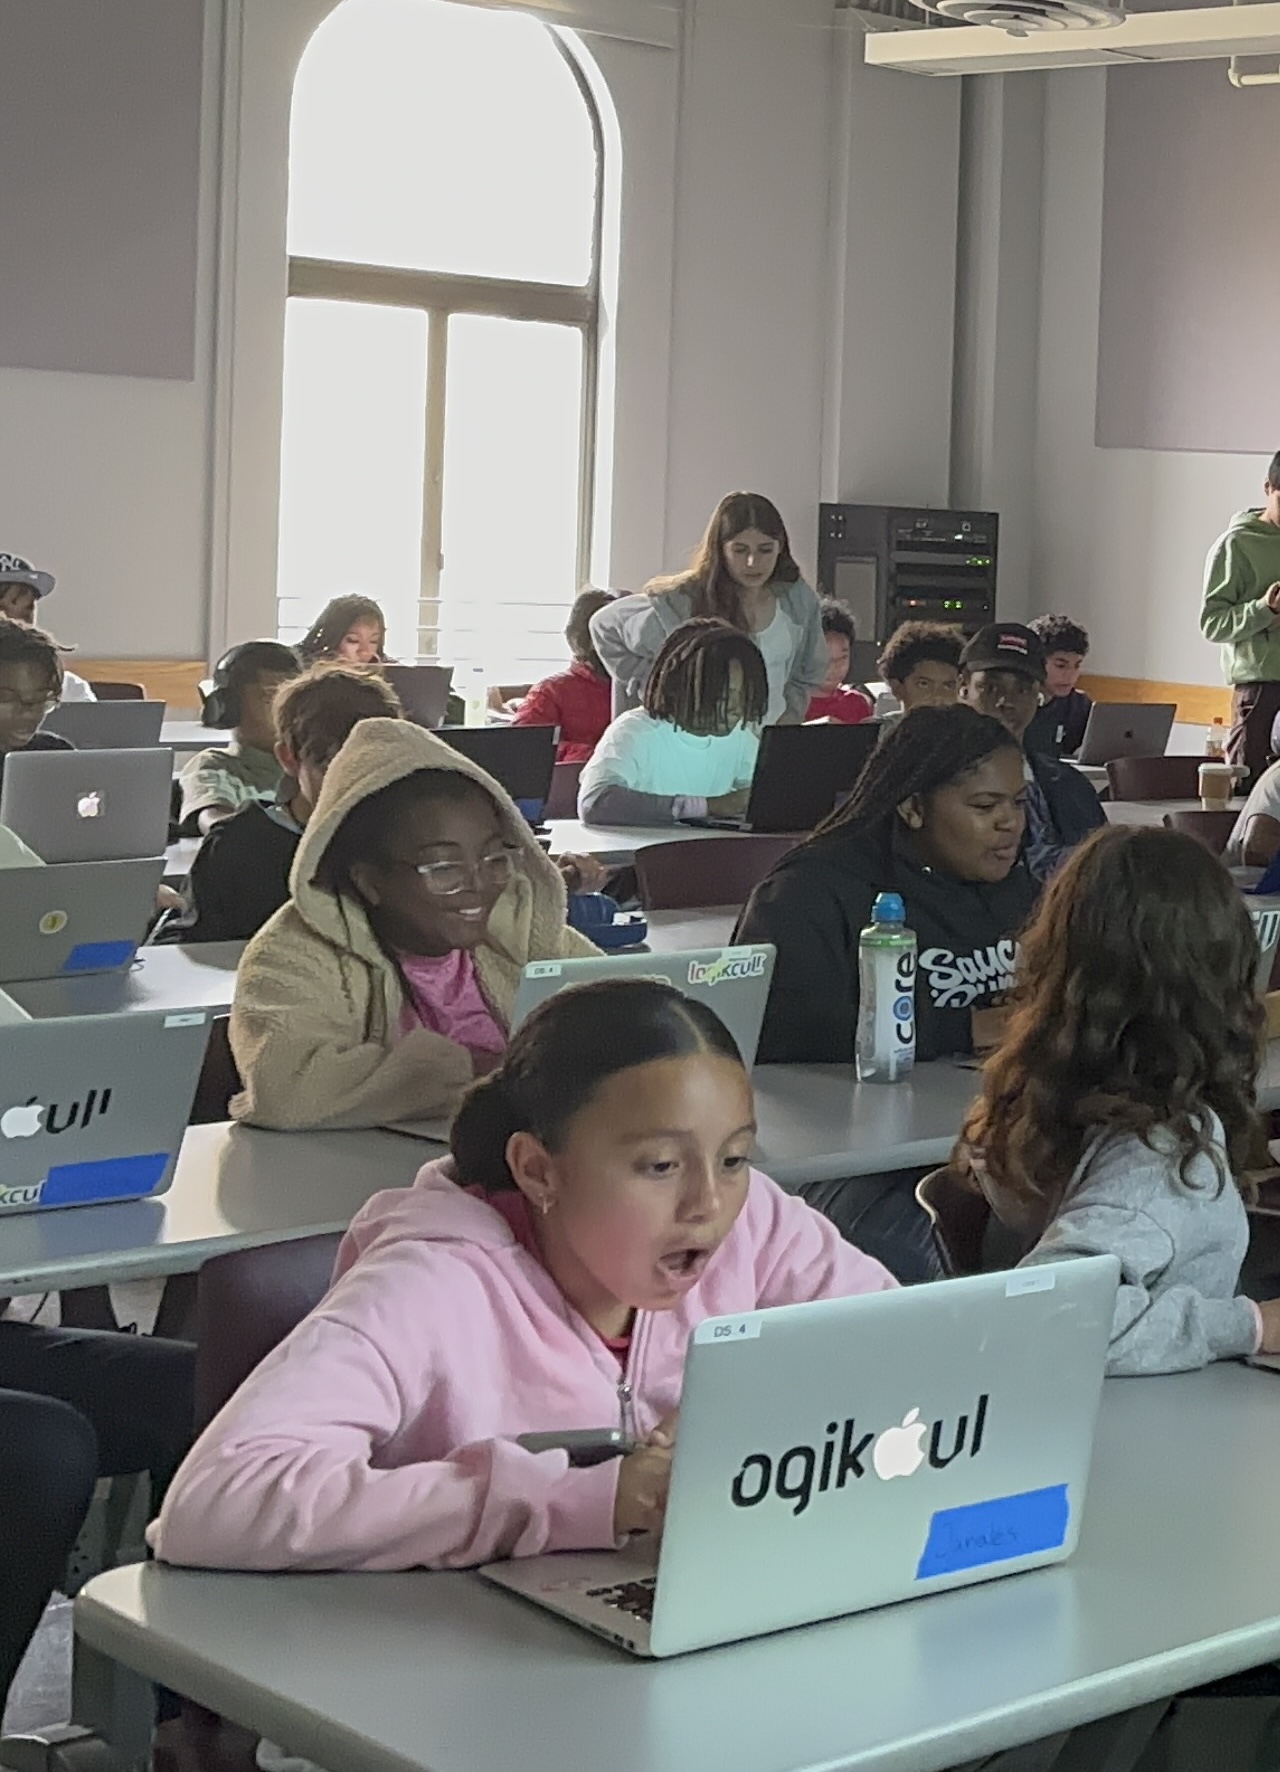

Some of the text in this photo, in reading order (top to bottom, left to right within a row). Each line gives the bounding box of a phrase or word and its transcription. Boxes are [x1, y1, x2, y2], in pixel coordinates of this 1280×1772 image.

[918, 939, 1021, 989] Sauc
[893, 951, 915, 1045] core
[738, 1323, 746, 1335] 4
